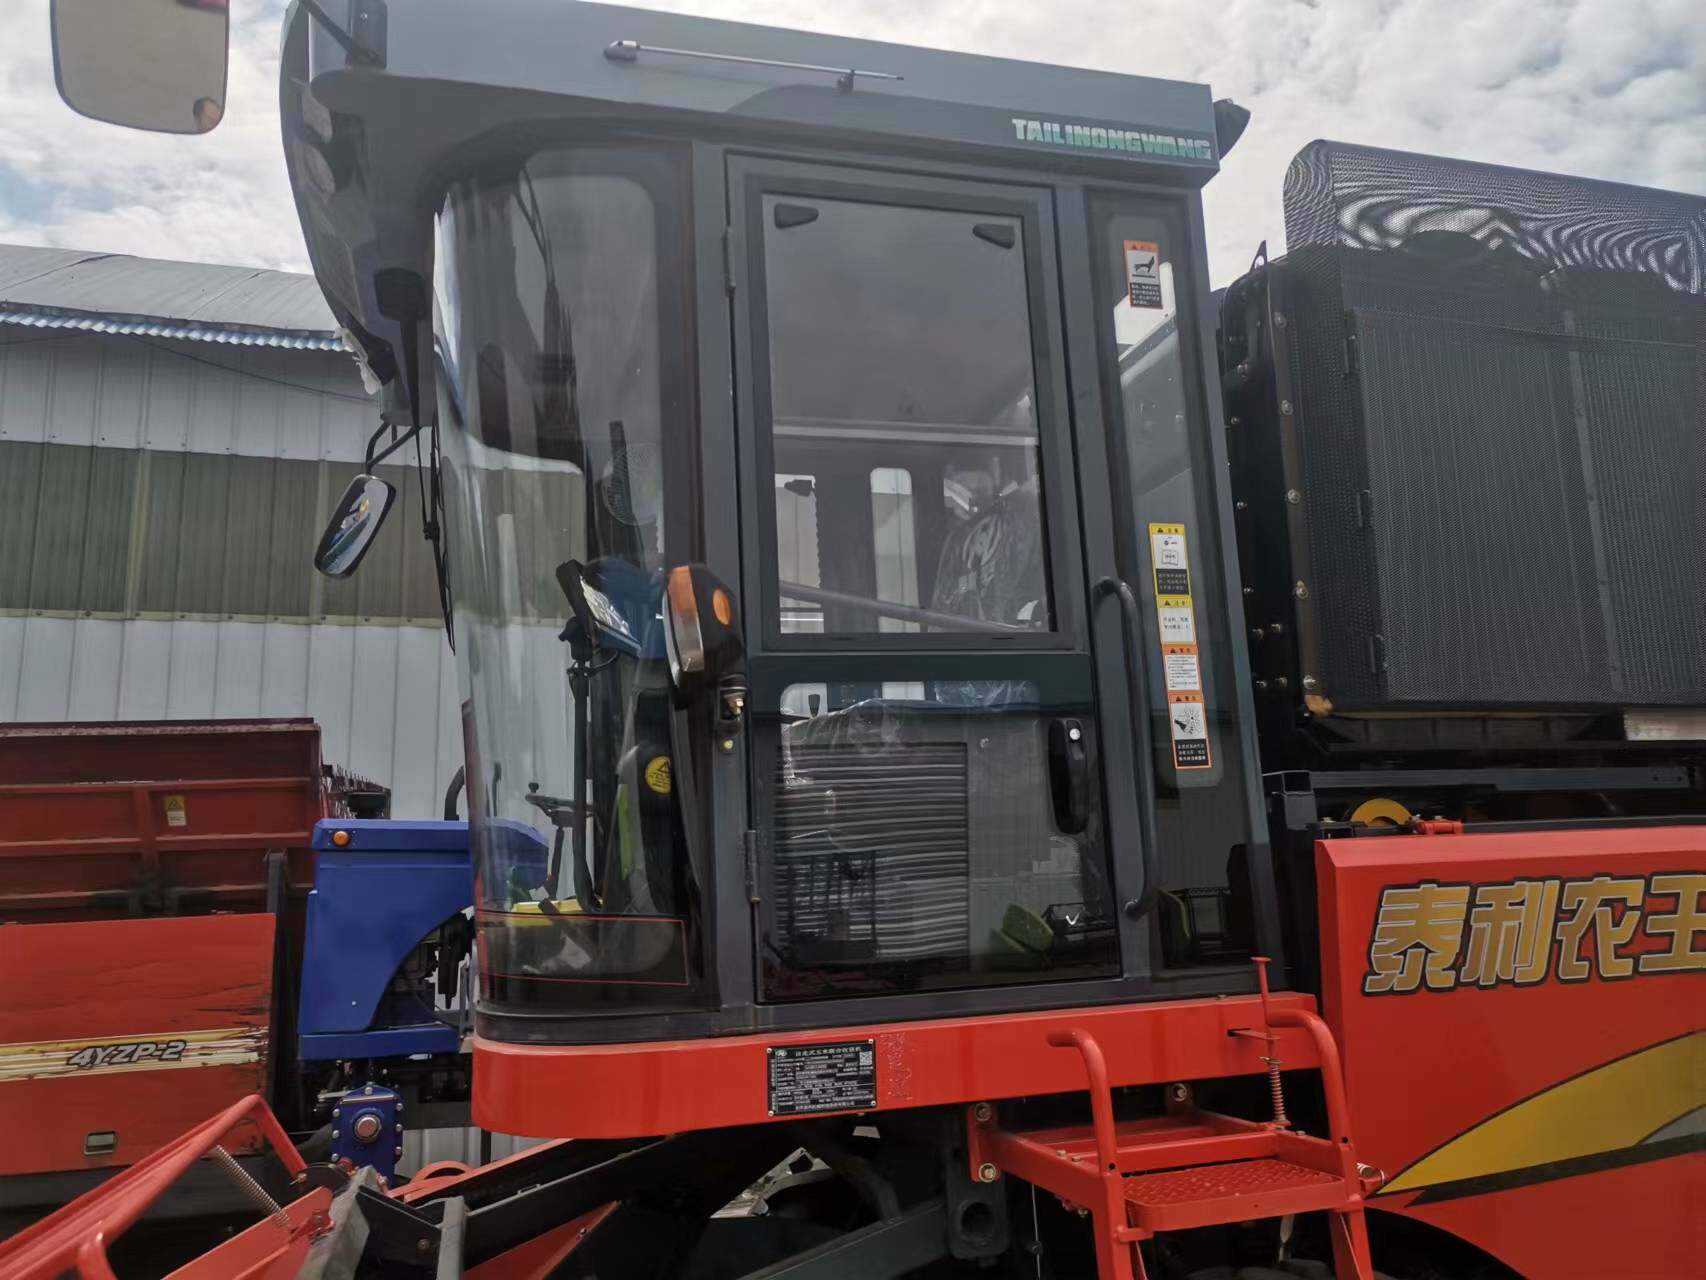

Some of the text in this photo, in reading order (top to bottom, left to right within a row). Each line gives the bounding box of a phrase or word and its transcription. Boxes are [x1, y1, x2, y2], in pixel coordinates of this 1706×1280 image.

[1011, 118, 1212, 160] TAILINONGWANG
[1363, 872, 1706, 995] 泰利农王
